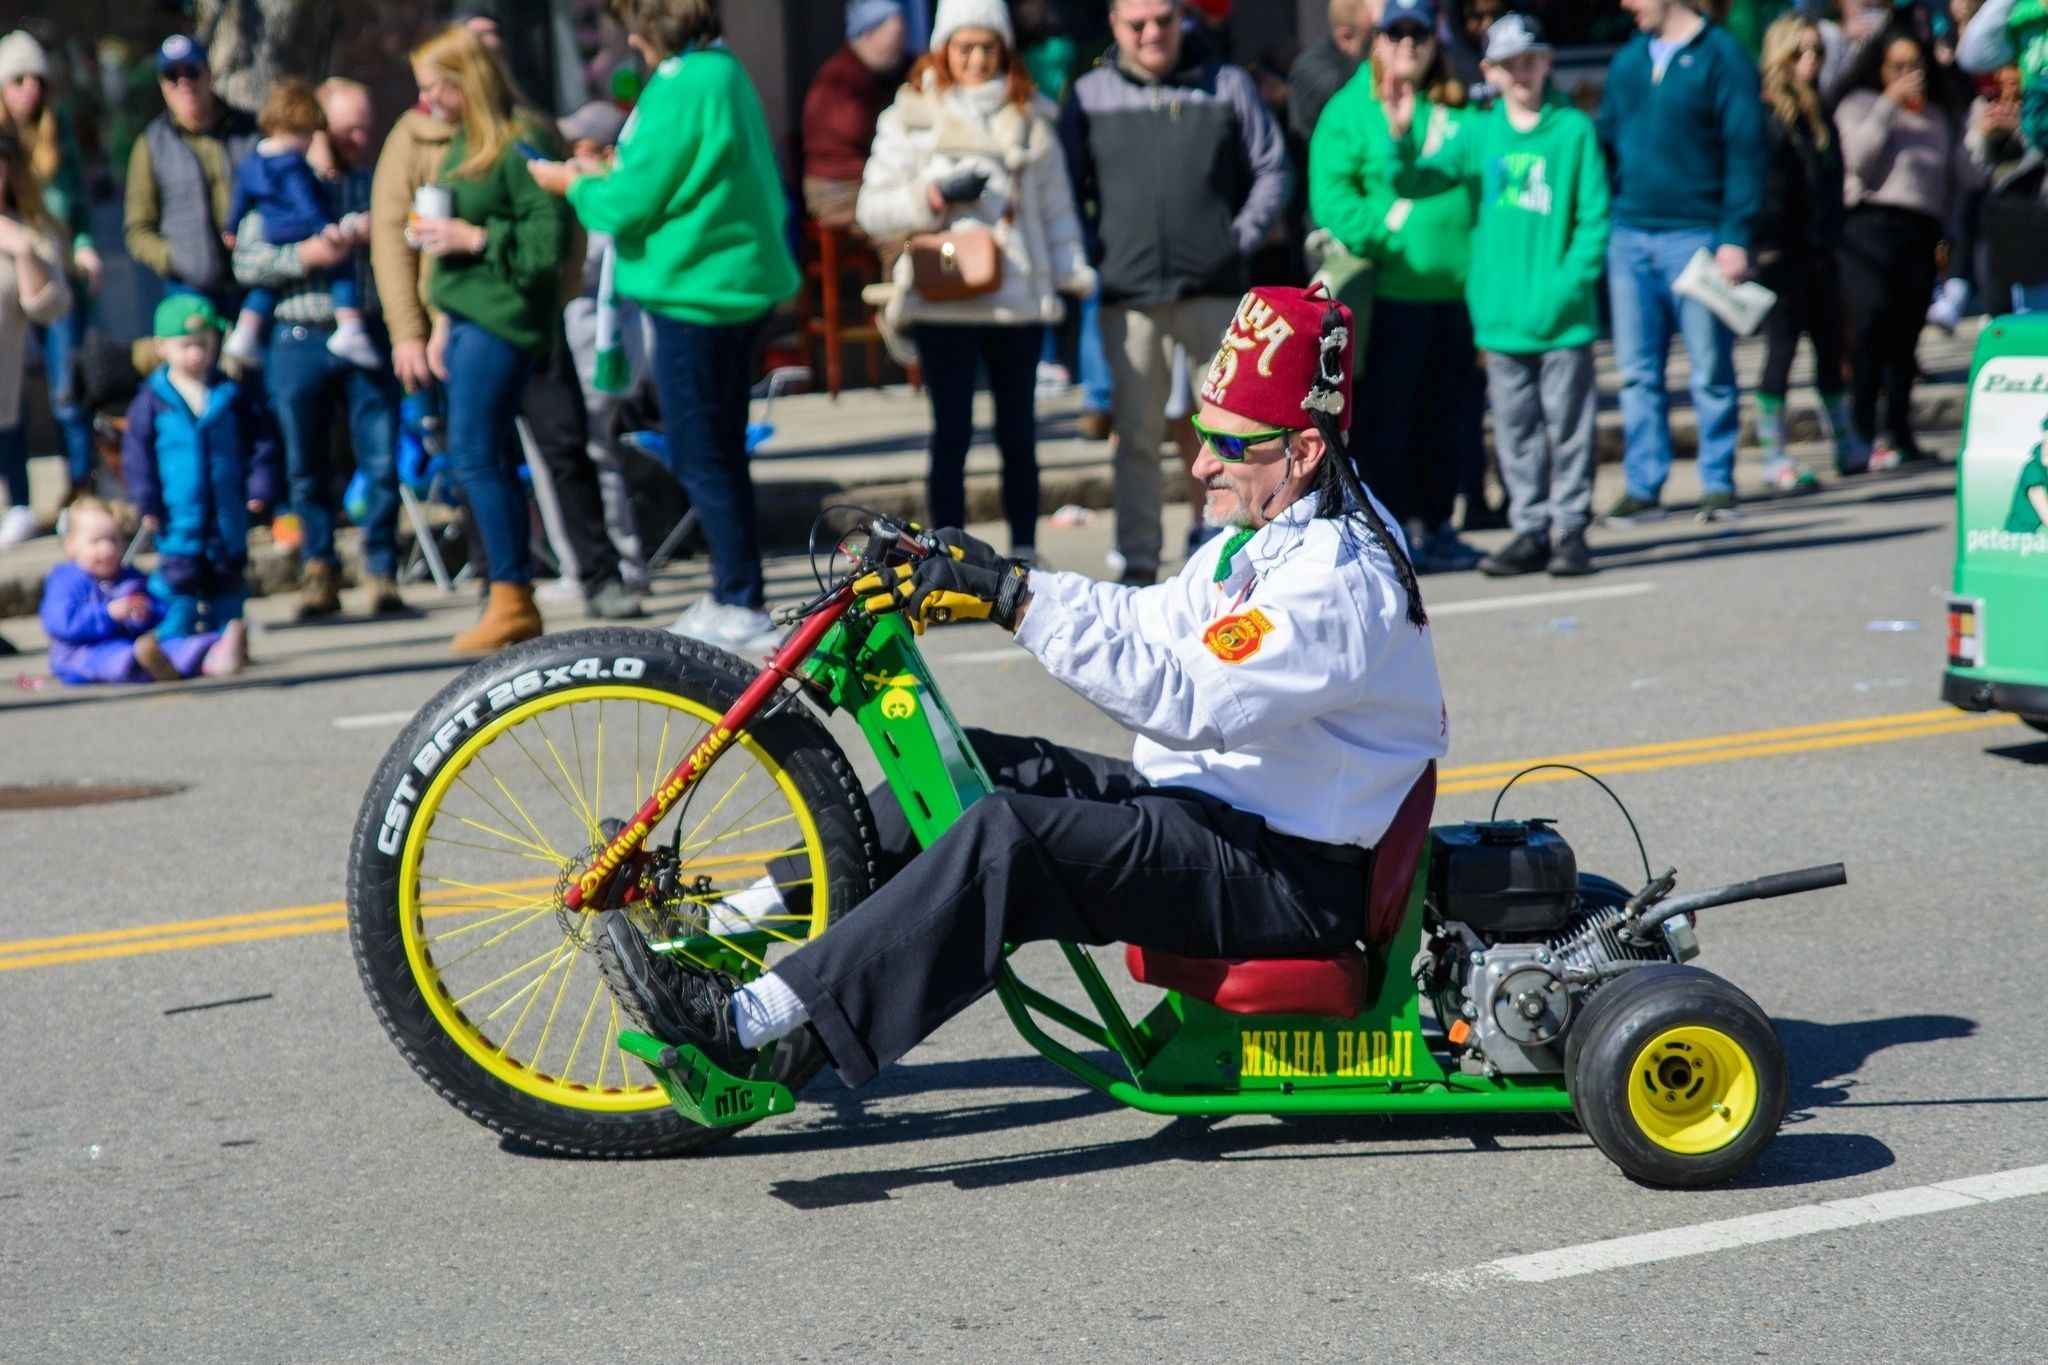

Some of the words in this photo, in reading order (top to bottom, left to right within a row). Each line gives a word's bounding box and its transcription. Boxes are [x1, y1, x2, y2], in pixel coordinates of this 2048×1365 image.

[377, 773, 419, 857] CST
[412, 700, 482, 777] BFT
[486, 656, 647, 712] 26x4.0
[580, 821, 648, 900] Drifting
[688, 726, 731, 781] Kids
[1240, 1030, 1328, 1077] MELHA
[1336, 1030, 1413, 1077] HADJI
